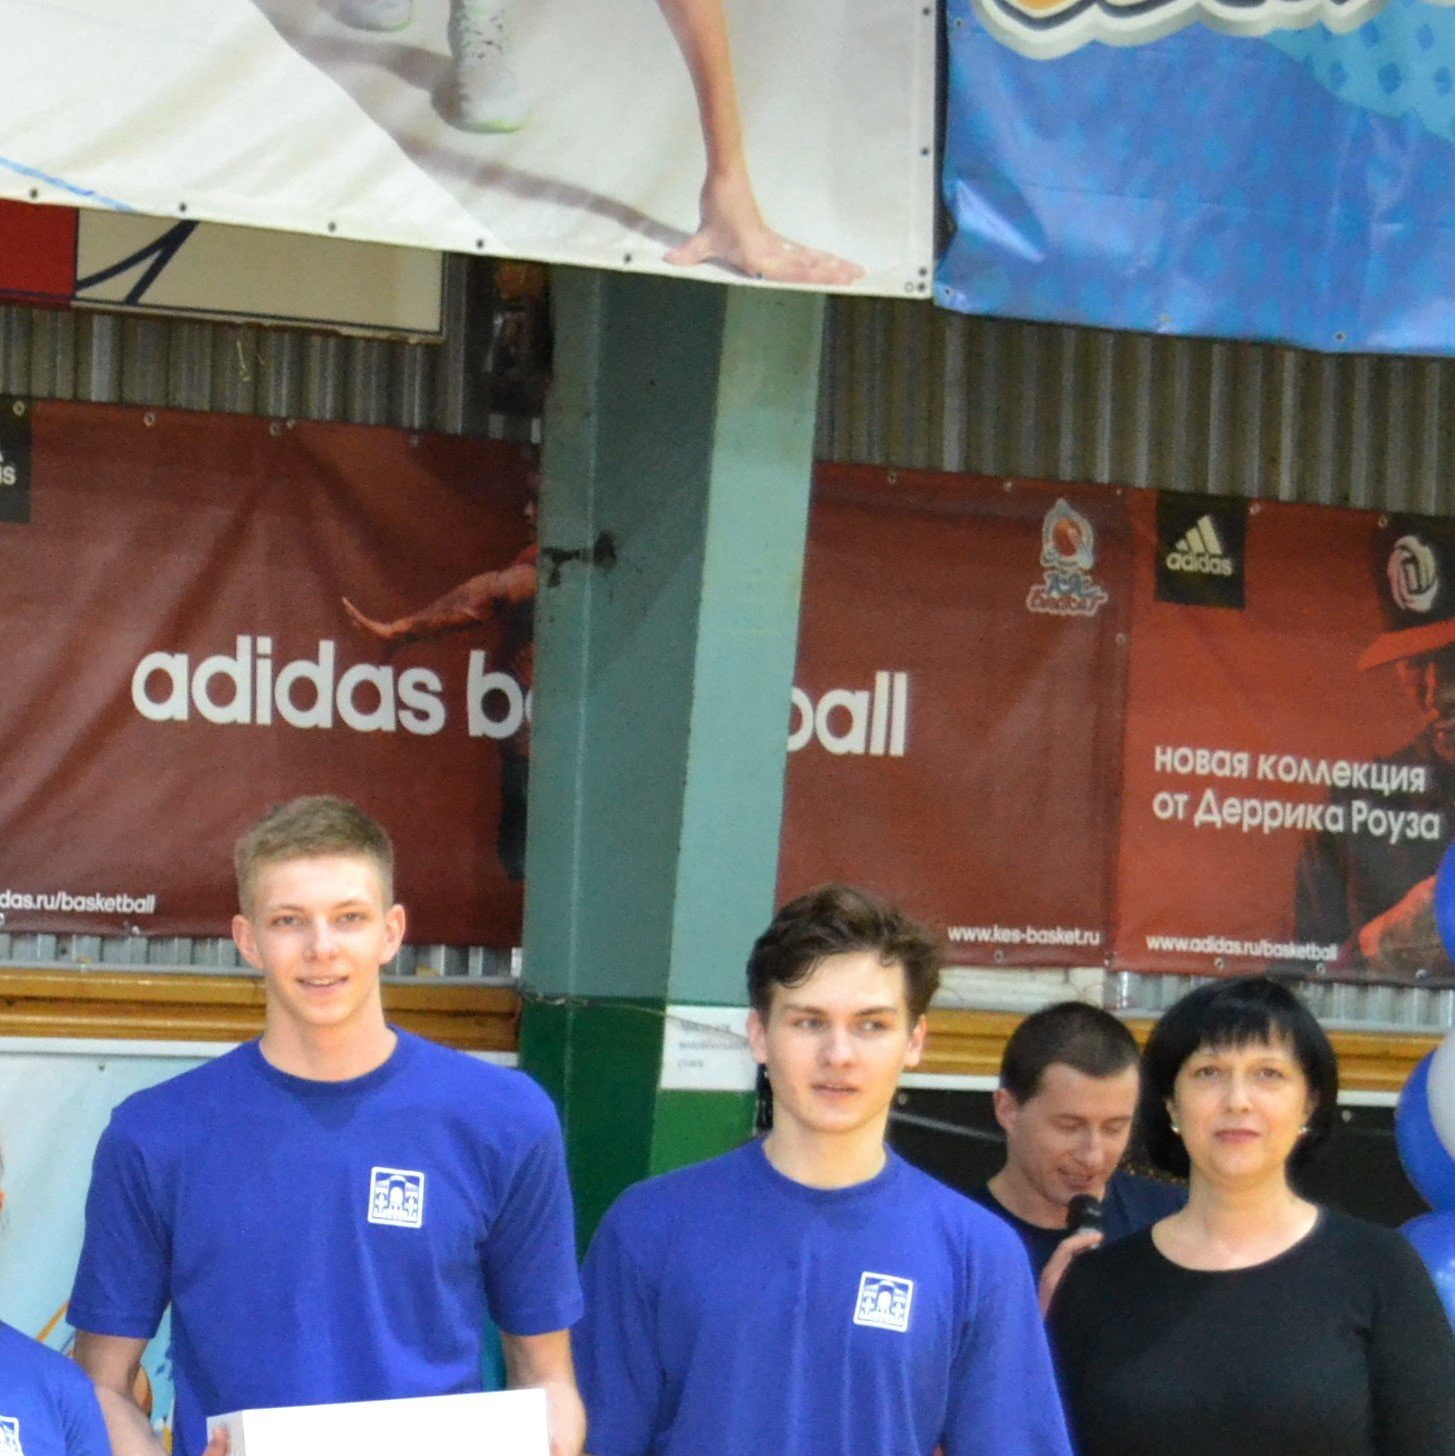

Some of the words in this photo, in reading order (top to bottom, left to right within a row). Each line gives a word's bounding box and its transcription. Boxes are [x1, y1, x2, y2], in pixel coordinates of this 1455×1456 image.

[1166, 549, 1234, 577] adidas
[131, 635, 446, 735] adidas
[1153, 744, 1250, 779] новая
[1256, 752, 1428, 797] коллекция
[1151, 791, 1189, 820] от
[1193, 787, 1345, 835] Деррика
[1350, 799, 1441, 845] Роуза
[947, 924, 1101, 948] www.kes-basket.ru
[1146, 934, 1339, 963] www.adidas.ru/basketball
